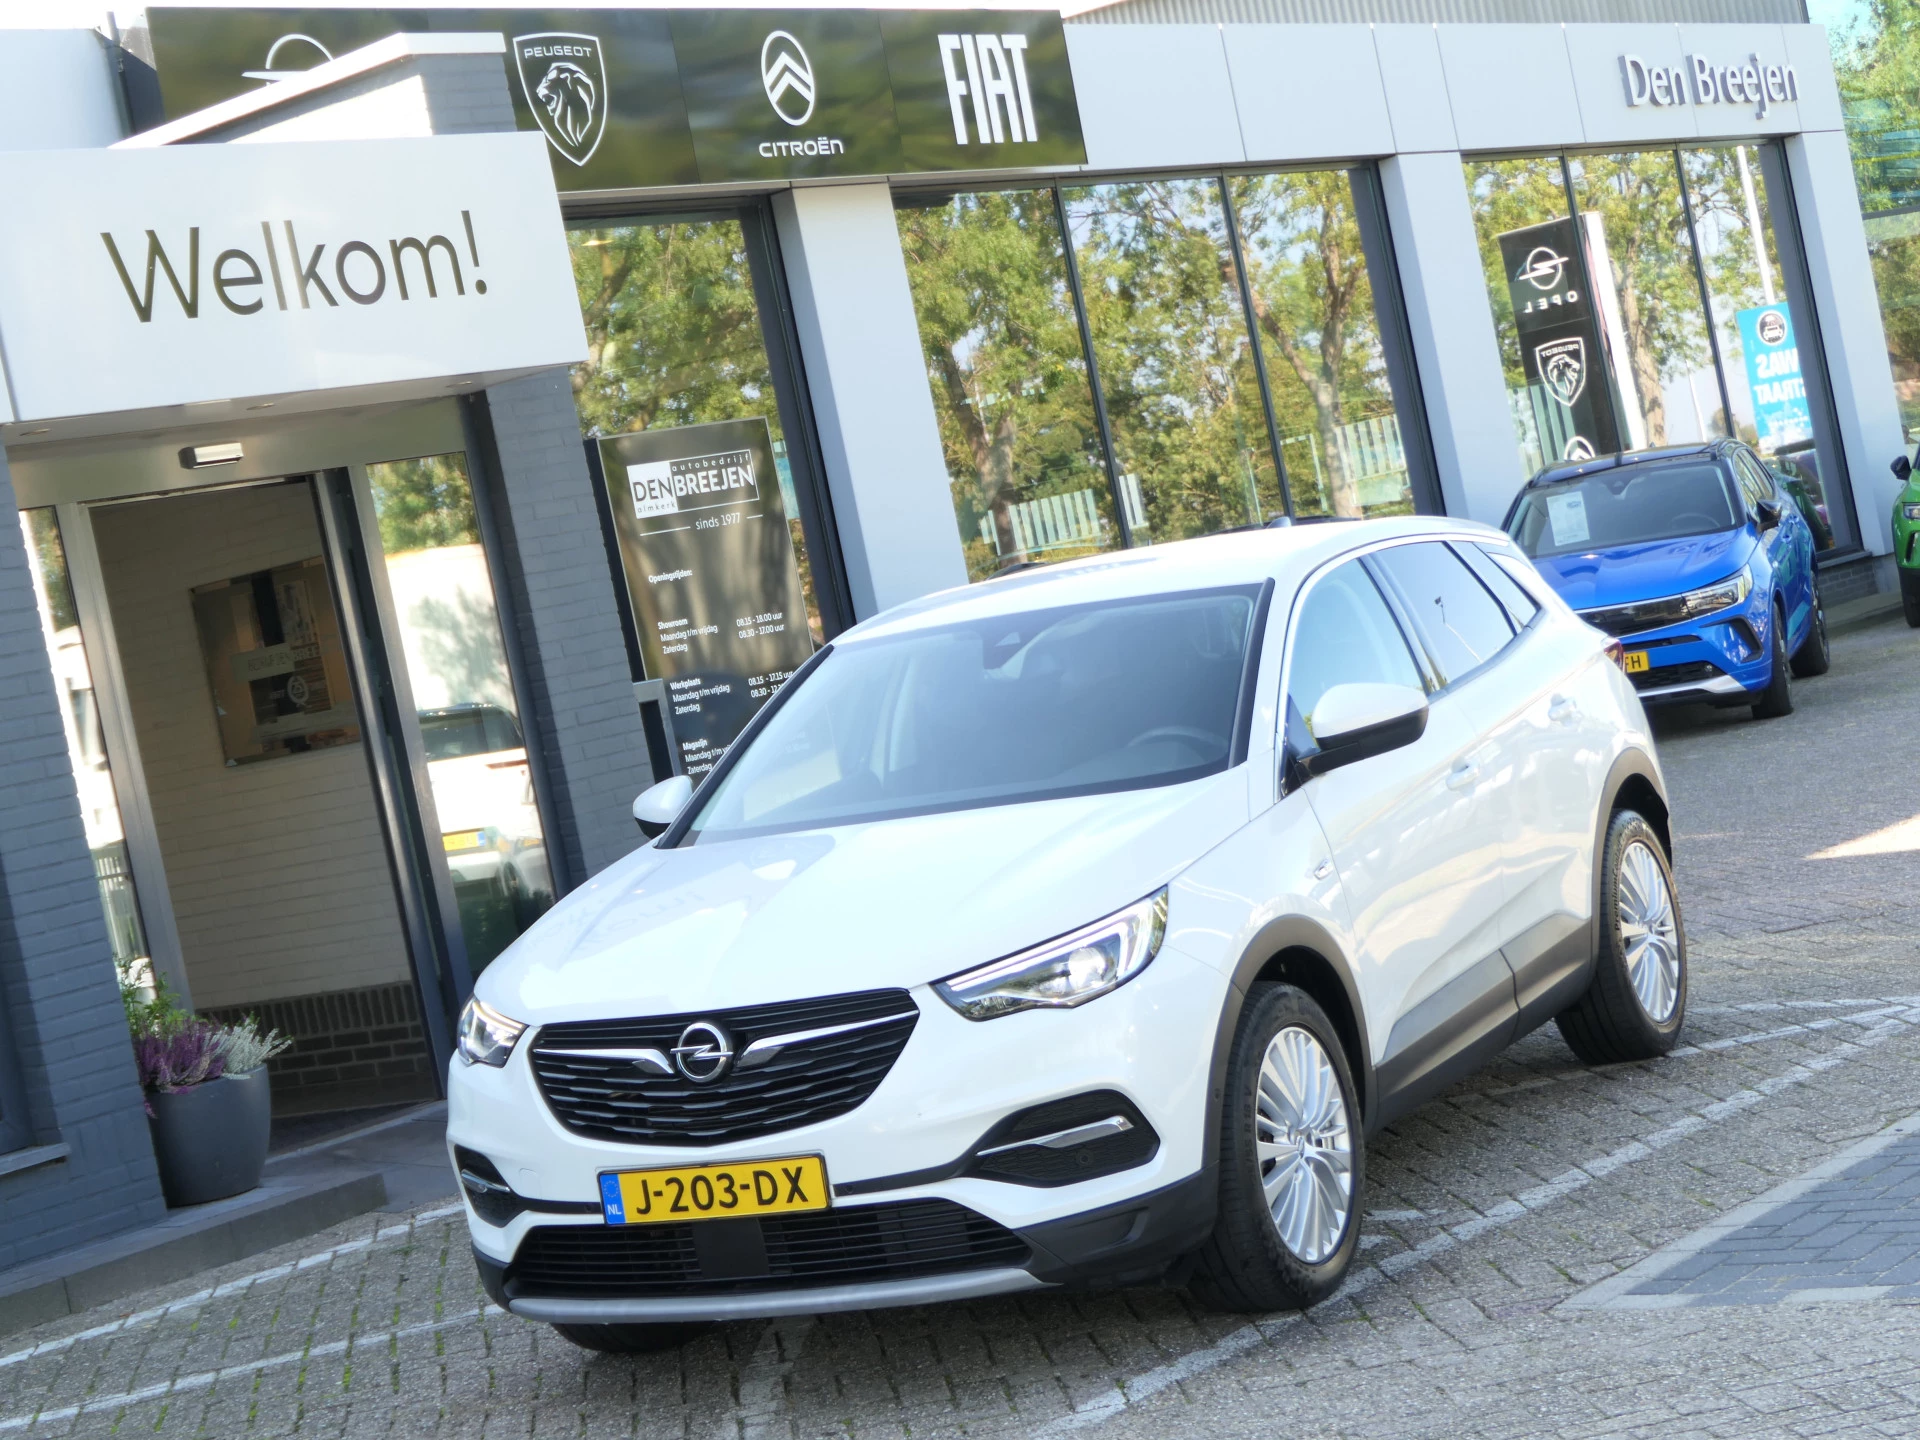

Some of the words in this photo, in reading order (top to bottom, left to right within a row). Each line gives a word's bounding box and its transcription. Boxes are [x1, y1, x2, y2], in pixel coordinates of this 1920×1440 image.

[523, 45, 593, 60] PEUGEOT
[937, 34, 1039, 145] FIAT
[1617, 53, 1688, 108] Den
[1686, 51, 1800, 120] Breejen
[100, 210, 488, 323] Welkom!
[671, 452, 749, 472] autobedrijf
[632, 477, 674, 502] DEN
[673, 464, 755, 497] BREEJEN
[637, 501, 677, 513] almkerk
[695, 517, 720, 530] sinds
[721, 511, 741, 526] 1977
[648, 569, 693, 584] Openingstijden:
[657, 618, 689, 630] Showroom
[660, 630, 688, 642] Maandag
[698, 625, 719, 636] vrijdag
[772, 611, 783, 620] uur
[662, 643, 689, 655] Zaterdag
[775, 624, 785, 632] uur
[669, 677, 701, 691] Werkplaats
[672, 689, 700, 702] Maandag
[711, 684, 731, 695] vrijdag
[674, 703, 701, 715] Zaterdag
[682, 738, 708, 751] Magazijn
[684, 750, 712, 763] Maandag
[687, 762, 713, 775] Zaterdag
[636, 1166, 809, 1216] J-203-DX
[606, 1203, 622, 1216] NL
